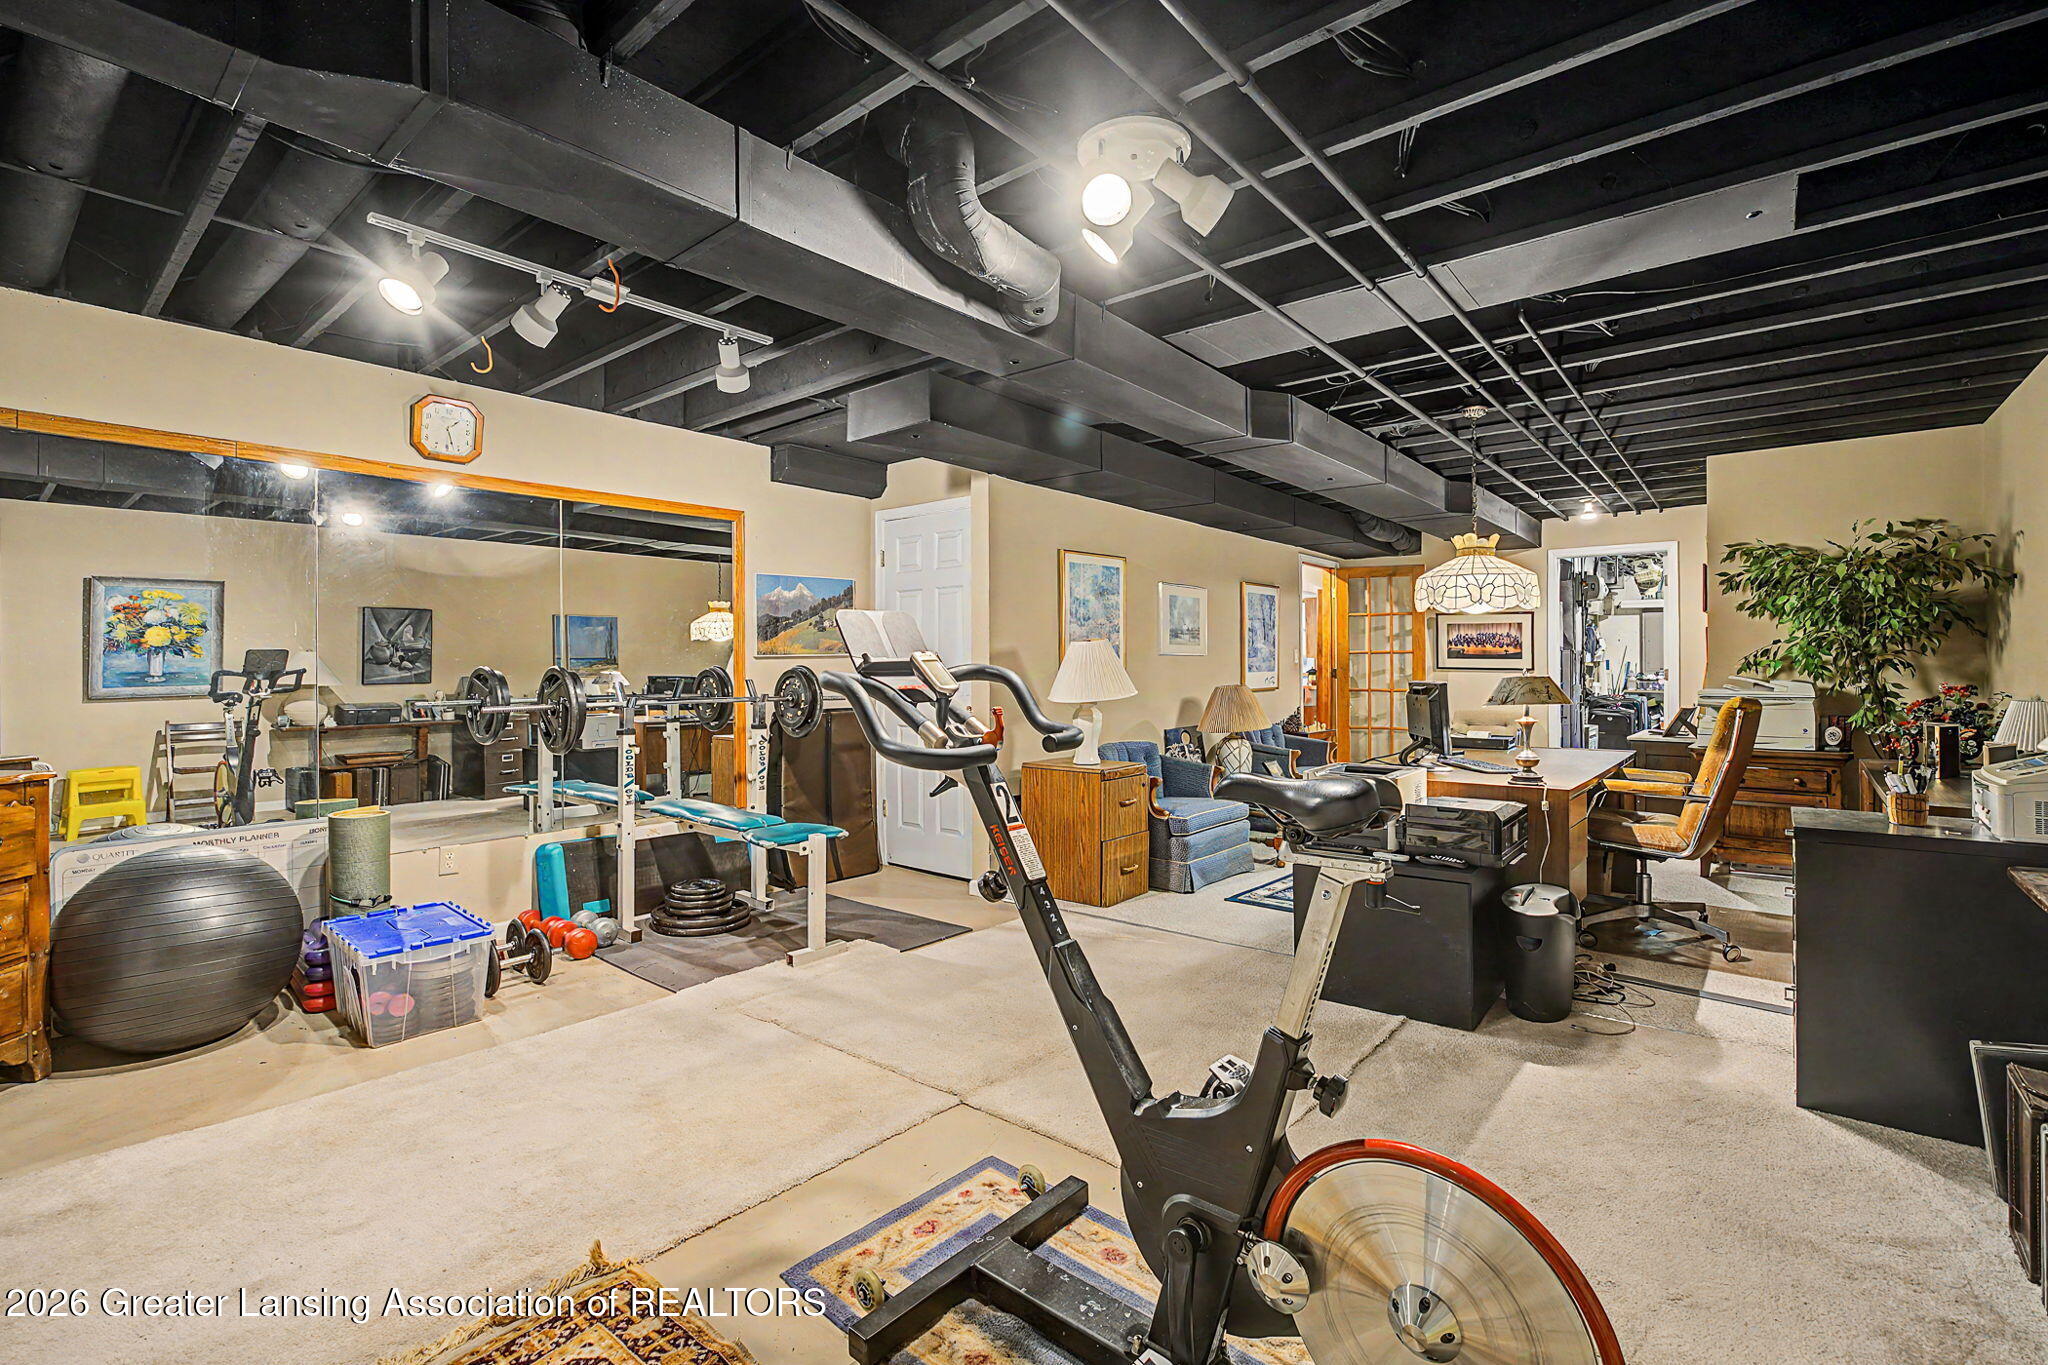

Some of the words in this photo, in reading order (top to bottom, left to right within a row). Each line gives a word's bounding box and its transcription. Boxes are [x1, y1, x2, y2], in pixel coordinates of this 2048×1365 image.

[995, 785, 1020, 824] 2
[239, 832, 280, 842] PLANNER
[989, 824, 1017, 876] KEISER
[1039, 886, 1046, 896] 4
[1049, 914, 1058, 923] 2
[1056, 926, 1063, 935] 1
